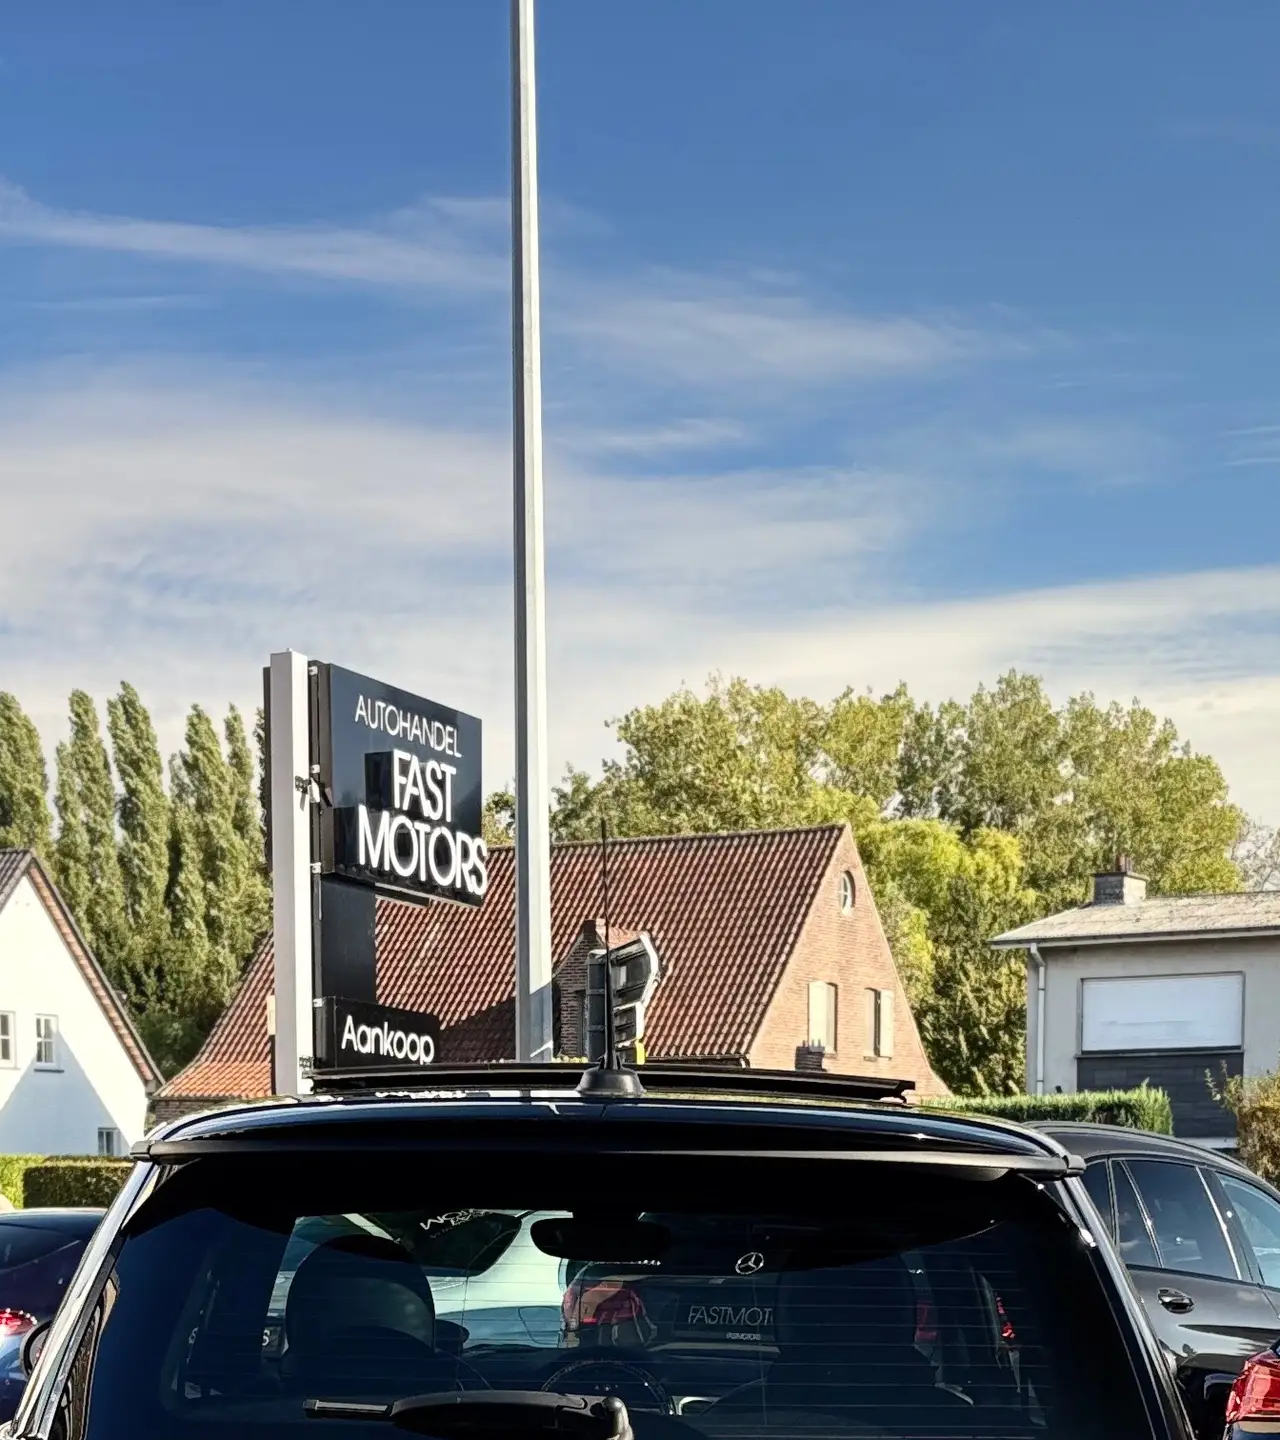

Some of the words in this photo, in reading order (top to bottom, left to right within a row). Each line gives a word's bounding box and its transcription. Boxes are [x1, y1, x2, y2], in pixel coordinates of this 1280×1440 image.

[354, 694, 463, 758] AUTOHANDEL
[393, 749, 457, 823] FAST
[358, 804, 488, 895] MOTORS
[341, 1014, 434, 1066] Aankoop
[688, 1305, 773, 1326] FASTMOT
